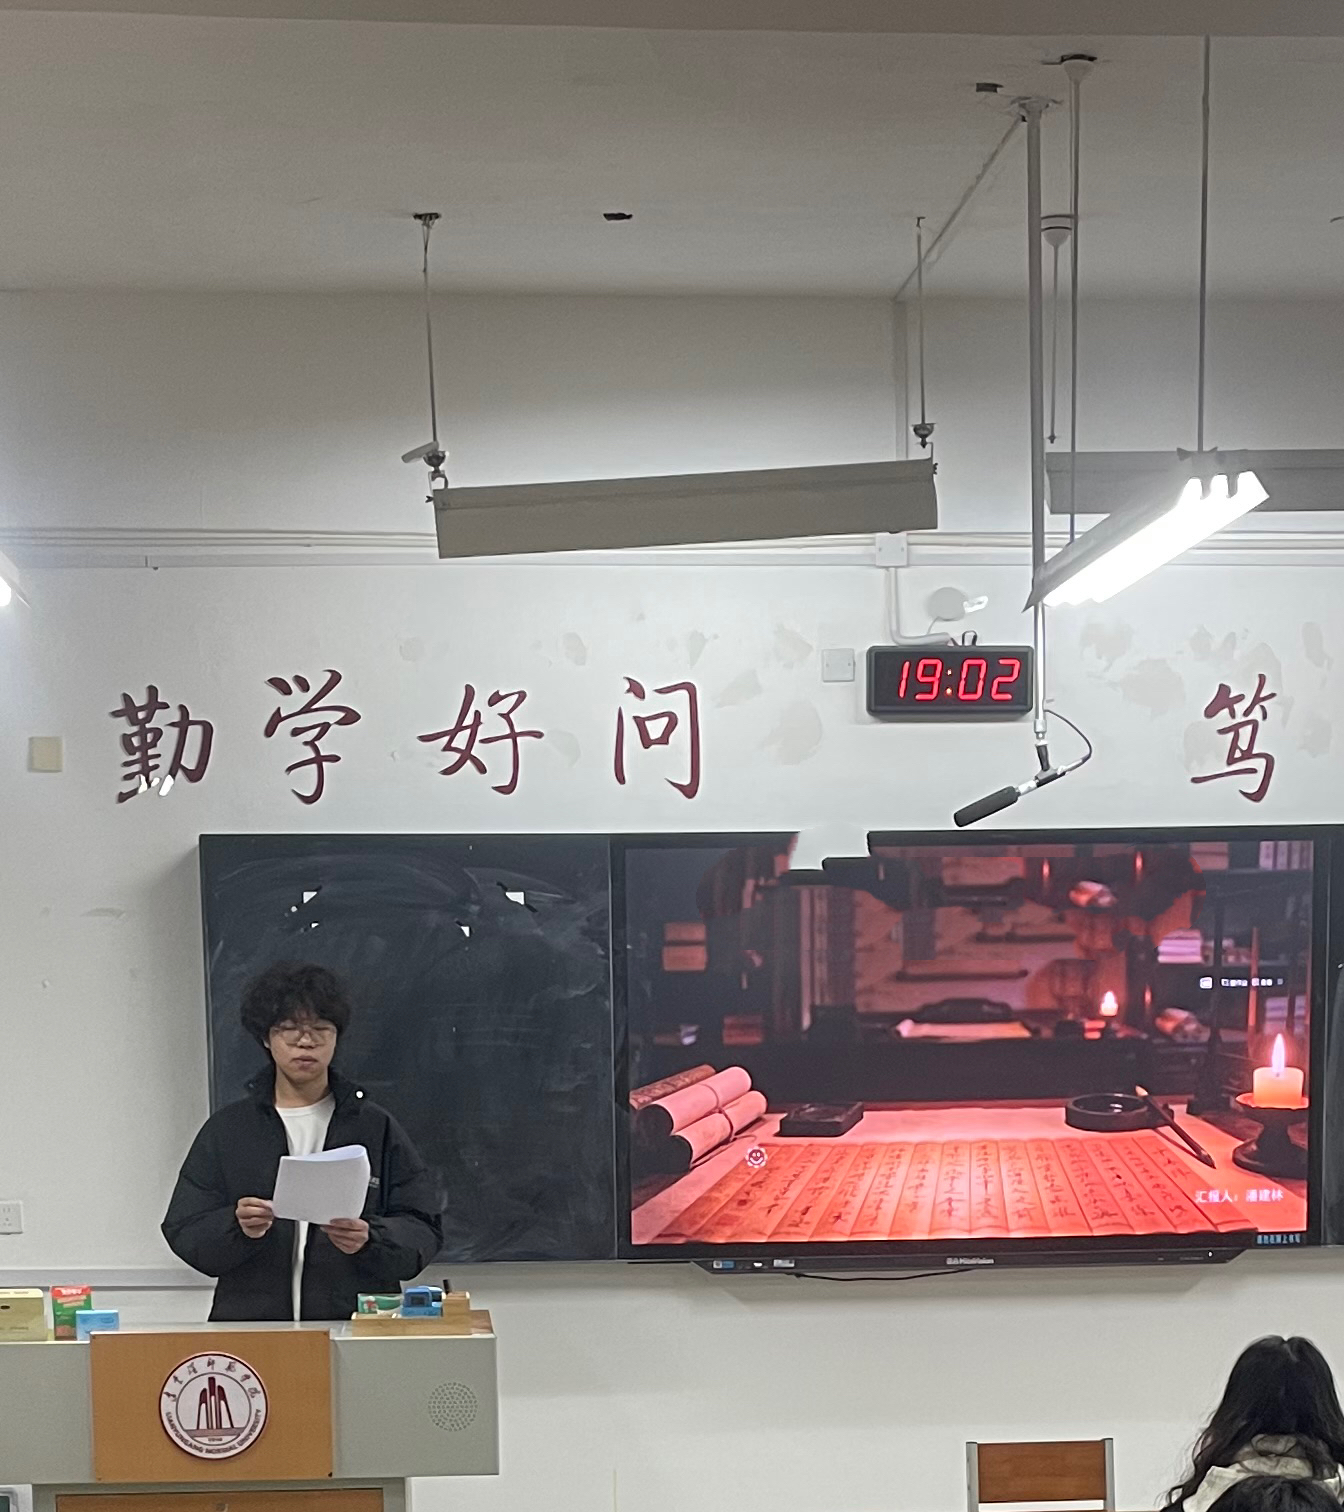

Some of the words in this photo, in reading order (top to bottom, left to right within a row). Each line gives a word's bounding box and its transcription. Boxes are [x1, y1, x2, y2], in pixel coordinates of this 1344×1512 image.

[897, 658, 1022, 703] 19:02
[111, 669, 700, 804] 勤学好问
[237, 1408, 262, 1447] UNIVERSITY
